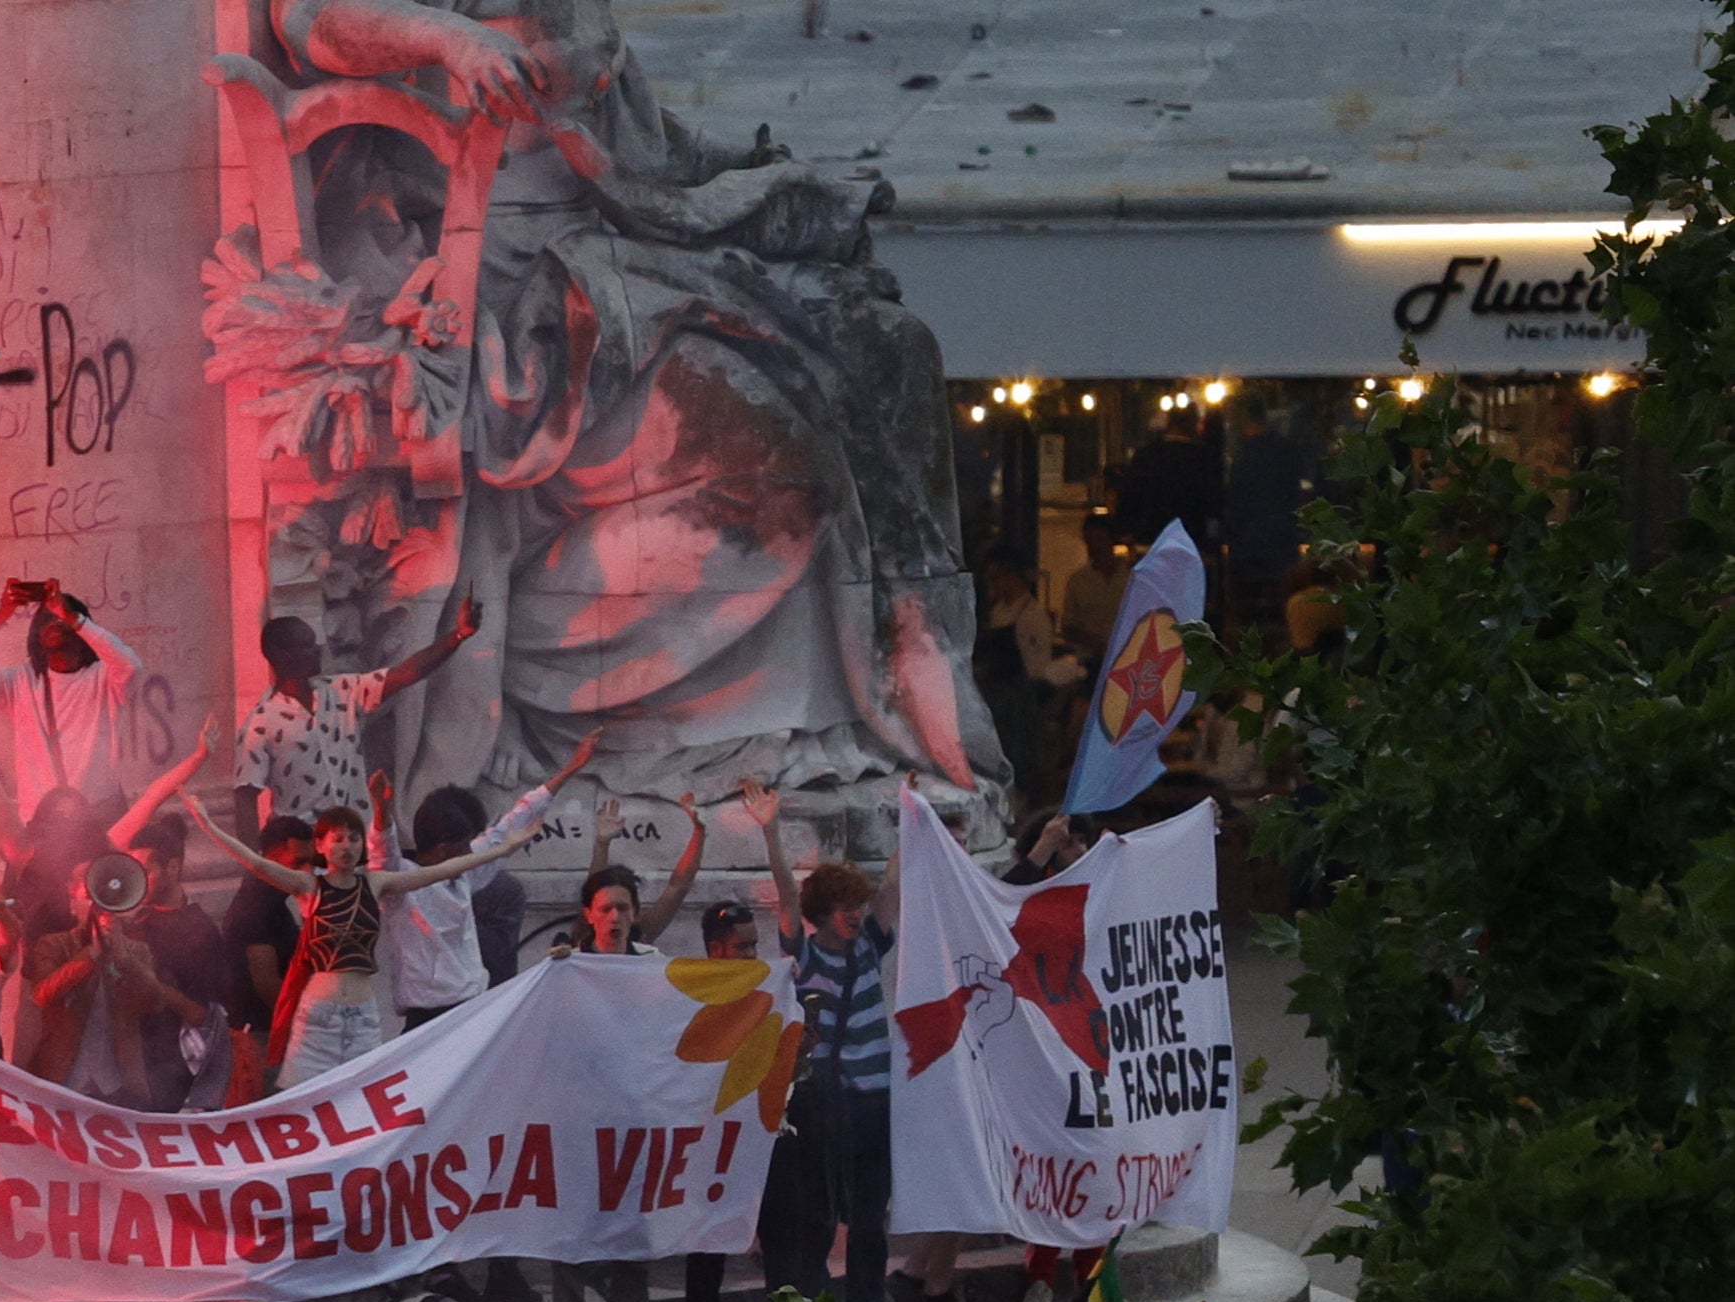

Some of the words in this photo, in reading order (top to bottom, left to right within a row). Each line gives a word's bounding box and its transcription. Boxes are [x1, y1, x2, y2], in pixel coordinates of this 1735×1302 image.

[38, 301, 136, 467] POP
[9, 478, 124, 546] FREE
[1100, 909, 1224, 994] JEUNESSE
[1087, 983, 1187, 1059] CONTRE
[1063, 1069, 1114, 1128] LE
[1118, 1044, 1233, 1125] FASCISE
[594, 1125, 705, 1217] VIE
